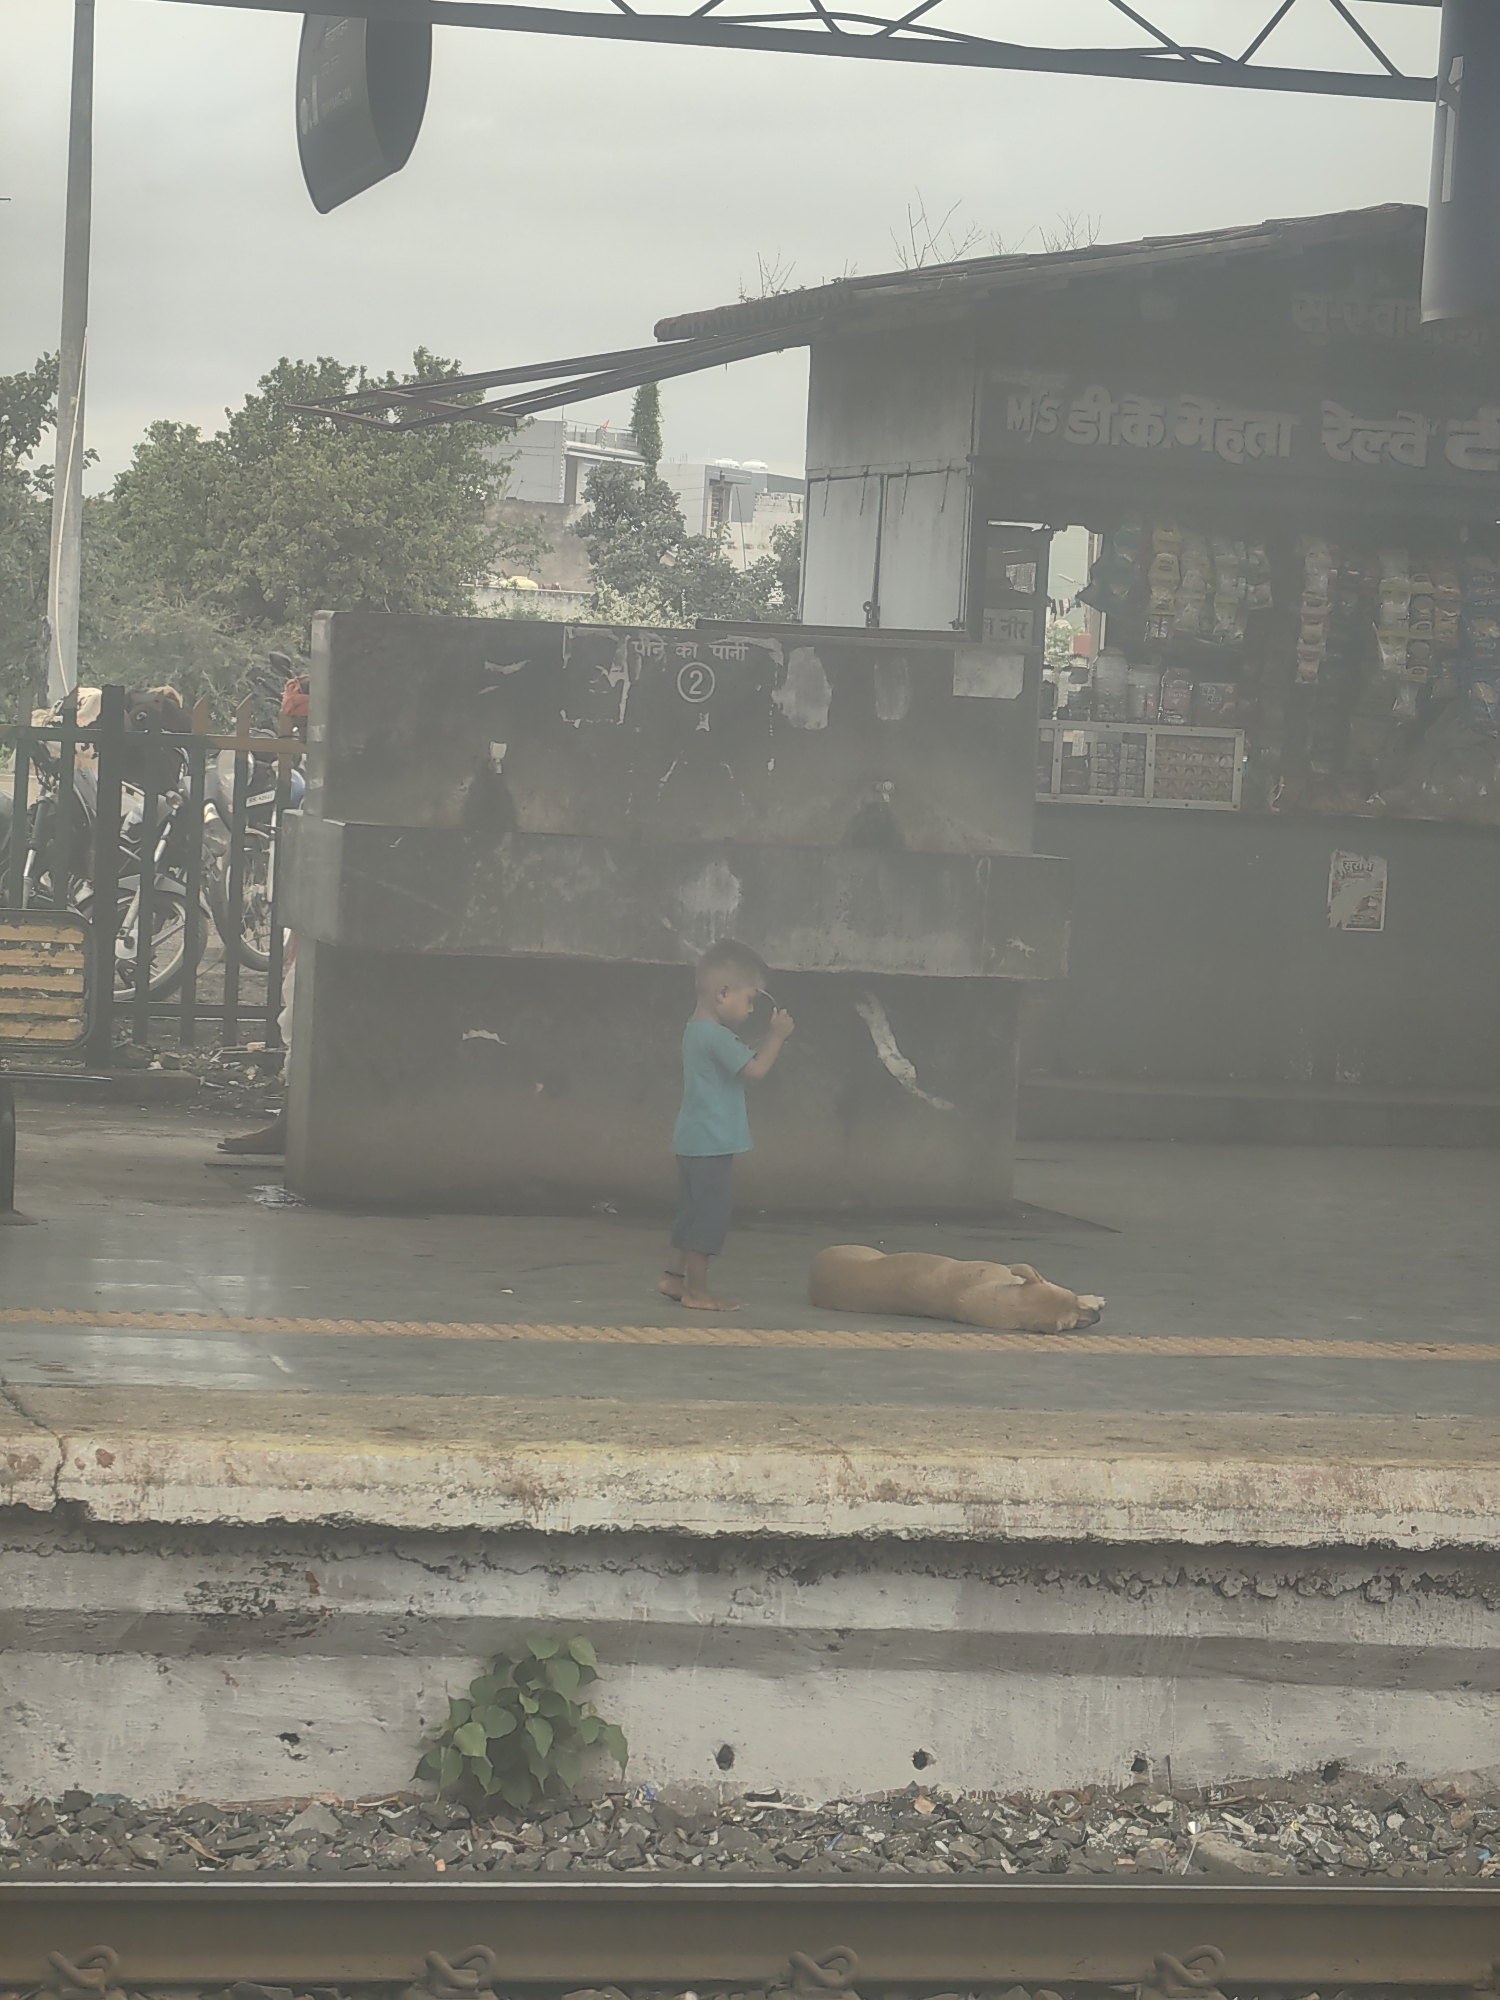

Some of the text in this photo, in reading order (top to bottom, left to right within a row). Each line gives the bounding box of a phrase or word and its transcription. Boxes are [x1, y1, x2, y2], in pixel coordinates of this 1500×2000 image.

[1006, 390, 1062, 443] M/S
[1000, 615, 1029, 640] नीर
[631, 639, 750, 662] पीने का पानी
